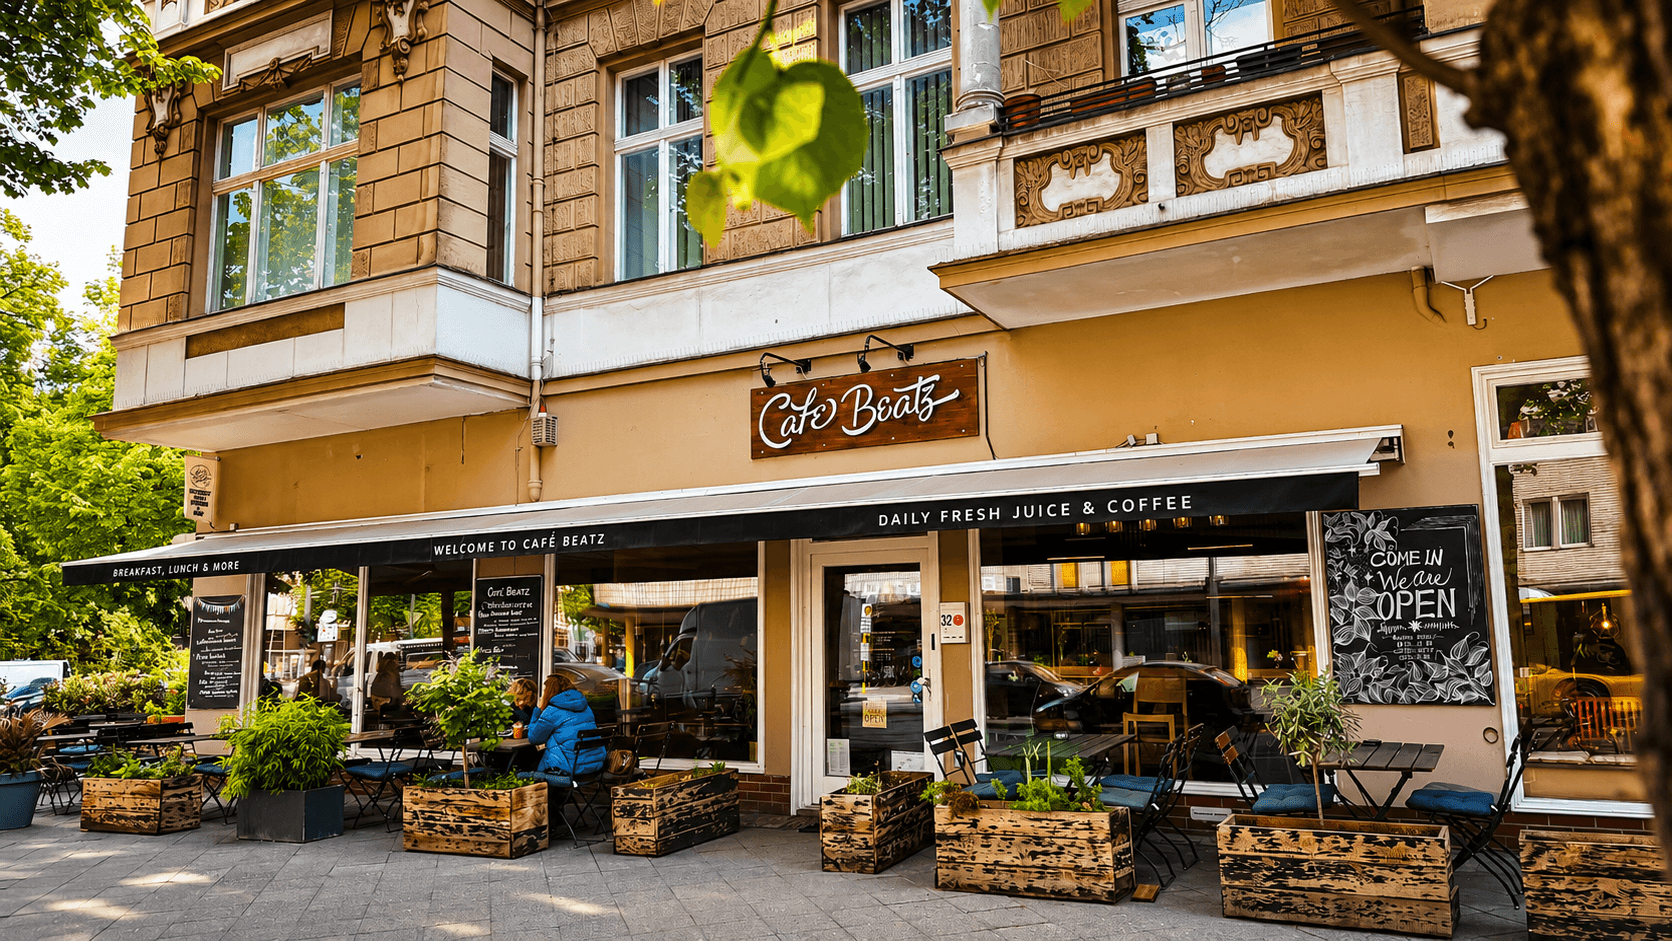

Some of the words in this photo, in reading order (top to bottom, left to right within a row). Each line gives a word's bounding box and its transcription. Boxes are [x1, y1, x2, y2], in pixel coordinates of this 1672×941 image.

[840, 374, 960, 436] Beatz
[878, 511, 931, 526] DAILY
[940, 507, 1000, 522] FRESH
[1012, 502, 1071, 519] JUICE
[1082, 501, 1096, 515] &
[1107, 495, 1192, 514] COFFEE
[433, 541, 495, 556] WELCOME
[500, 540, 517, 550] TO
[522, 530, 556, 550] CAFÉ
[562, 533, 605, 547] BEATZ
[113, 566, 165, 576] BREAKFAST,
[168, 563, 199, 574] LUNCH
[212, 560, 240, 571] MORE
[1370, 550, 1421, 567] COME
[1424, 548, 1444, 566] IN
[1376, 565, 1414, 591] We
[1376, 587, 1456, 621] OPEN
[941, 614, 952, 626] 32
